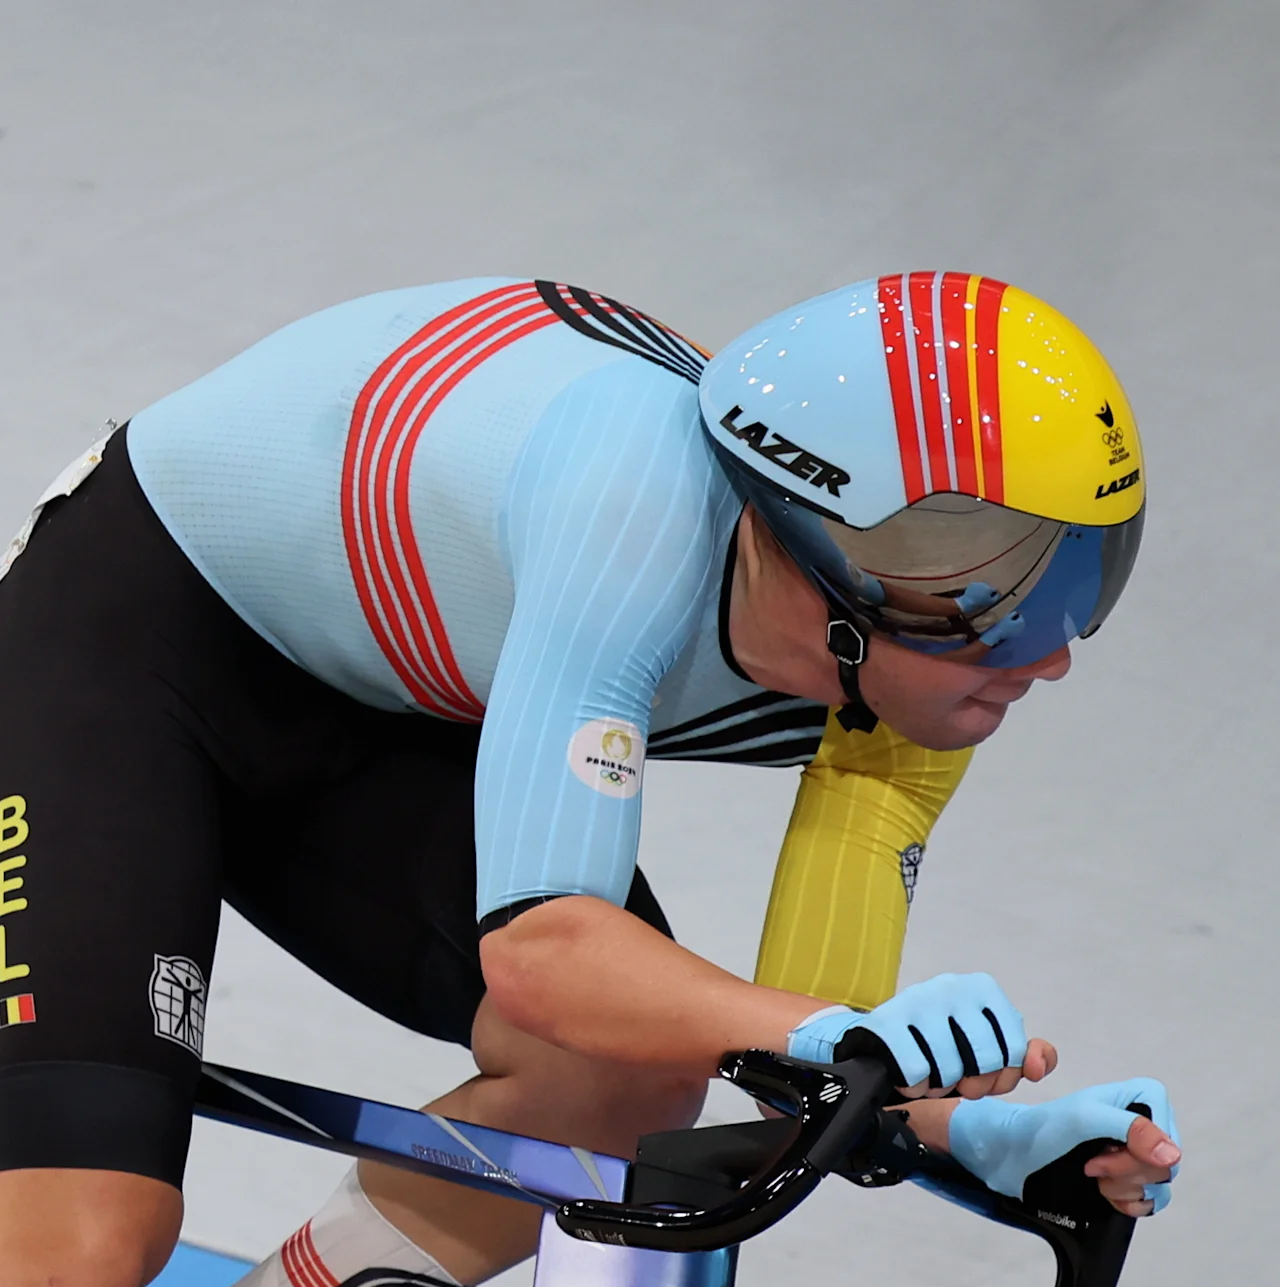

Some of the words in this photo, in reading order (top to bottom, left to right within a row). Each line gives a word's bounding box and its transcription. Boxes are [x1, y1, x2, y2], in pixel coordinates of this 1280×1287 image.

[719, 405, 851, 498] LAZER
[1094, 467, 1140, 500] LAZER
[585, 756, 616, 769] PARIS
[1037, 1209, 1077, 1230] velobike
